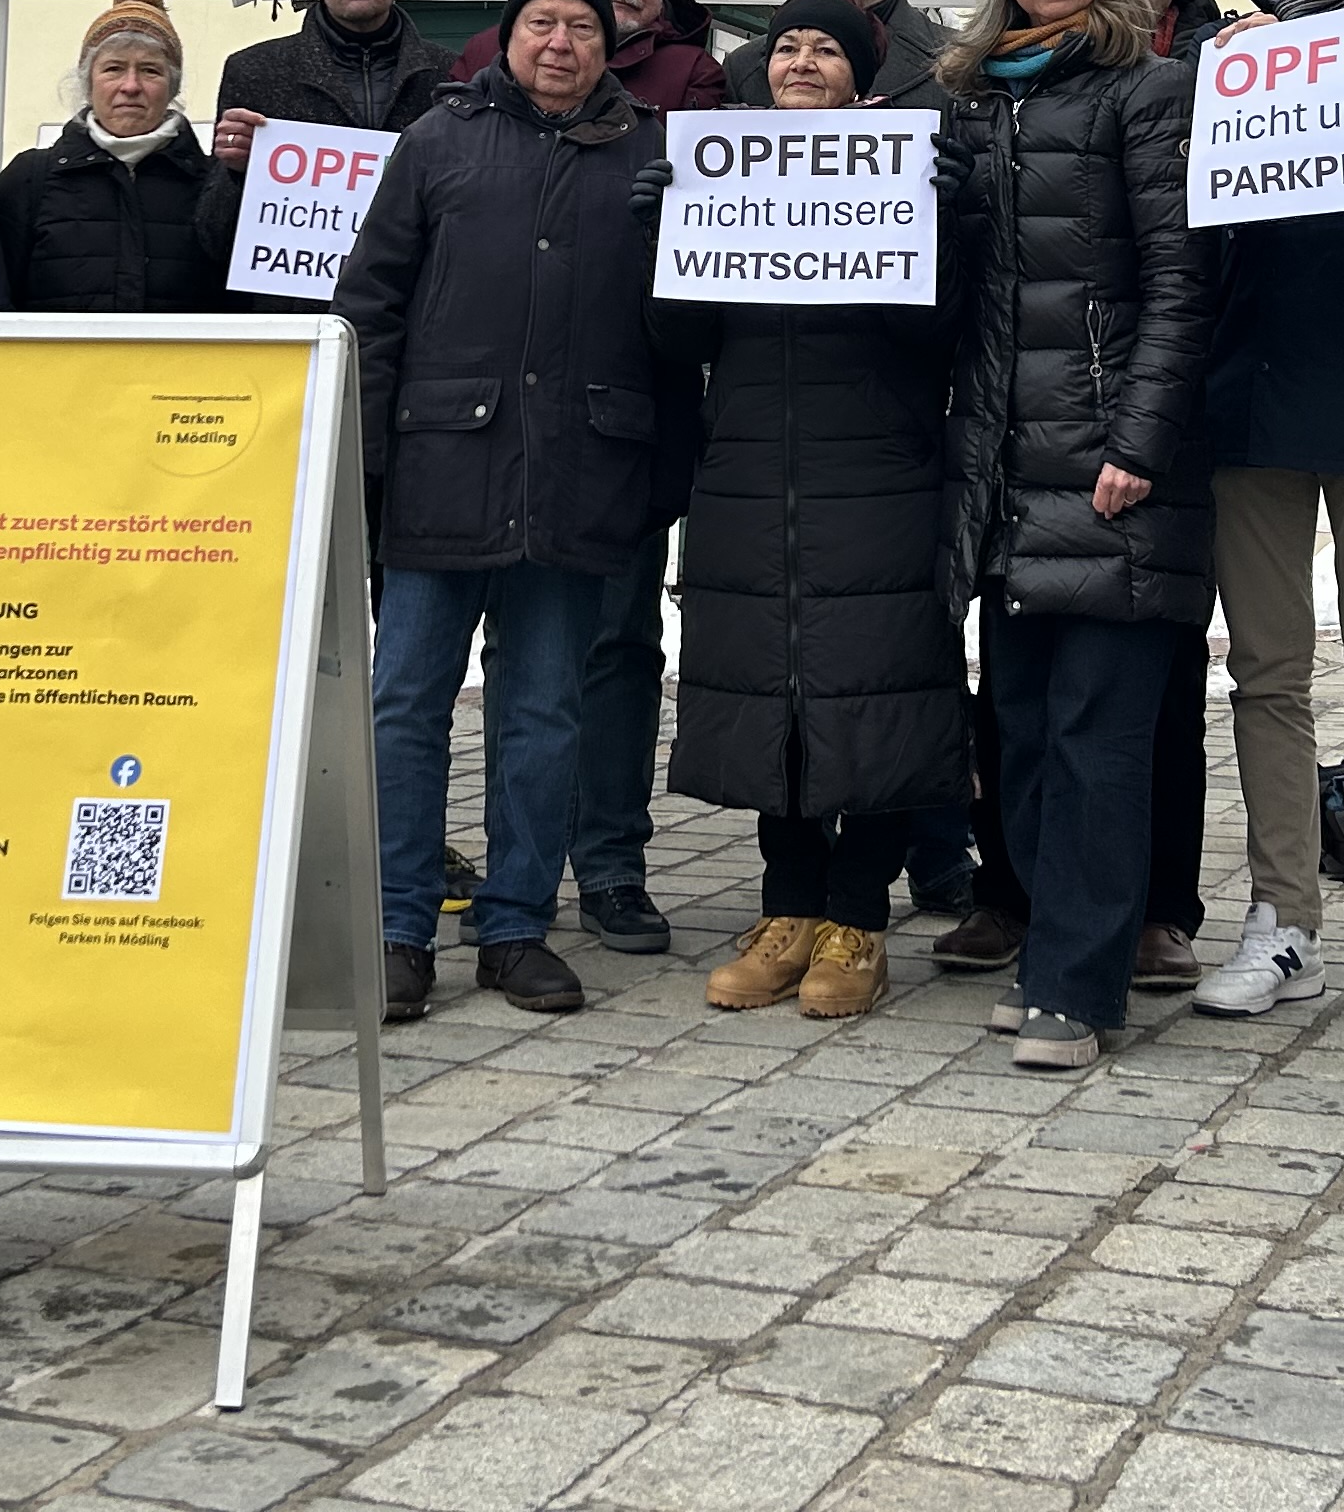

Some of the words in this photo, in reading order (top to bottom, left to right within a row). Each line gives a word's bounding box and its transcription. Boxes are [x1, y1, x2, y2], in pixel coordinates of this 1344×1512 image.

[1211, 102, 1308, 145] nicht
[694, 134, 914, 178] OPFERT
[268, 143, 391, 191] OPF
[258, 196, 344, 232] nicht
[683, 195, 776, 227] nicht
[787, 200, 914, 227] unsere
[673, 249, 918, 280] WIRTSCHAFT
[170, 412, 224, 424] Parken
[156, 430, 171, 444] in
[175, 431, 238, 447] Mödling
[10, 514, 79, 531] zuerst
[82, 514, 169, 533] zerstört
[173, 515, 252, 534] werden
[116, 548, 141, 562] zu
[145, 545, 239, 563] machen.
[44, 644, 73, 657] zur
[9, 689, 31, 704] im
[34, 688, 139, 706] öffentlichen
[29, 913, 70, 928] Folgen
[72, 913, 90, 926] Sie
[94, 915, 116, 927] uns
[118, 914, 141, 927] auf
[58, 931, 101, 945] Parken
[104, 931, 116, 945] in
[119, 933, 170, 950] Mödling
